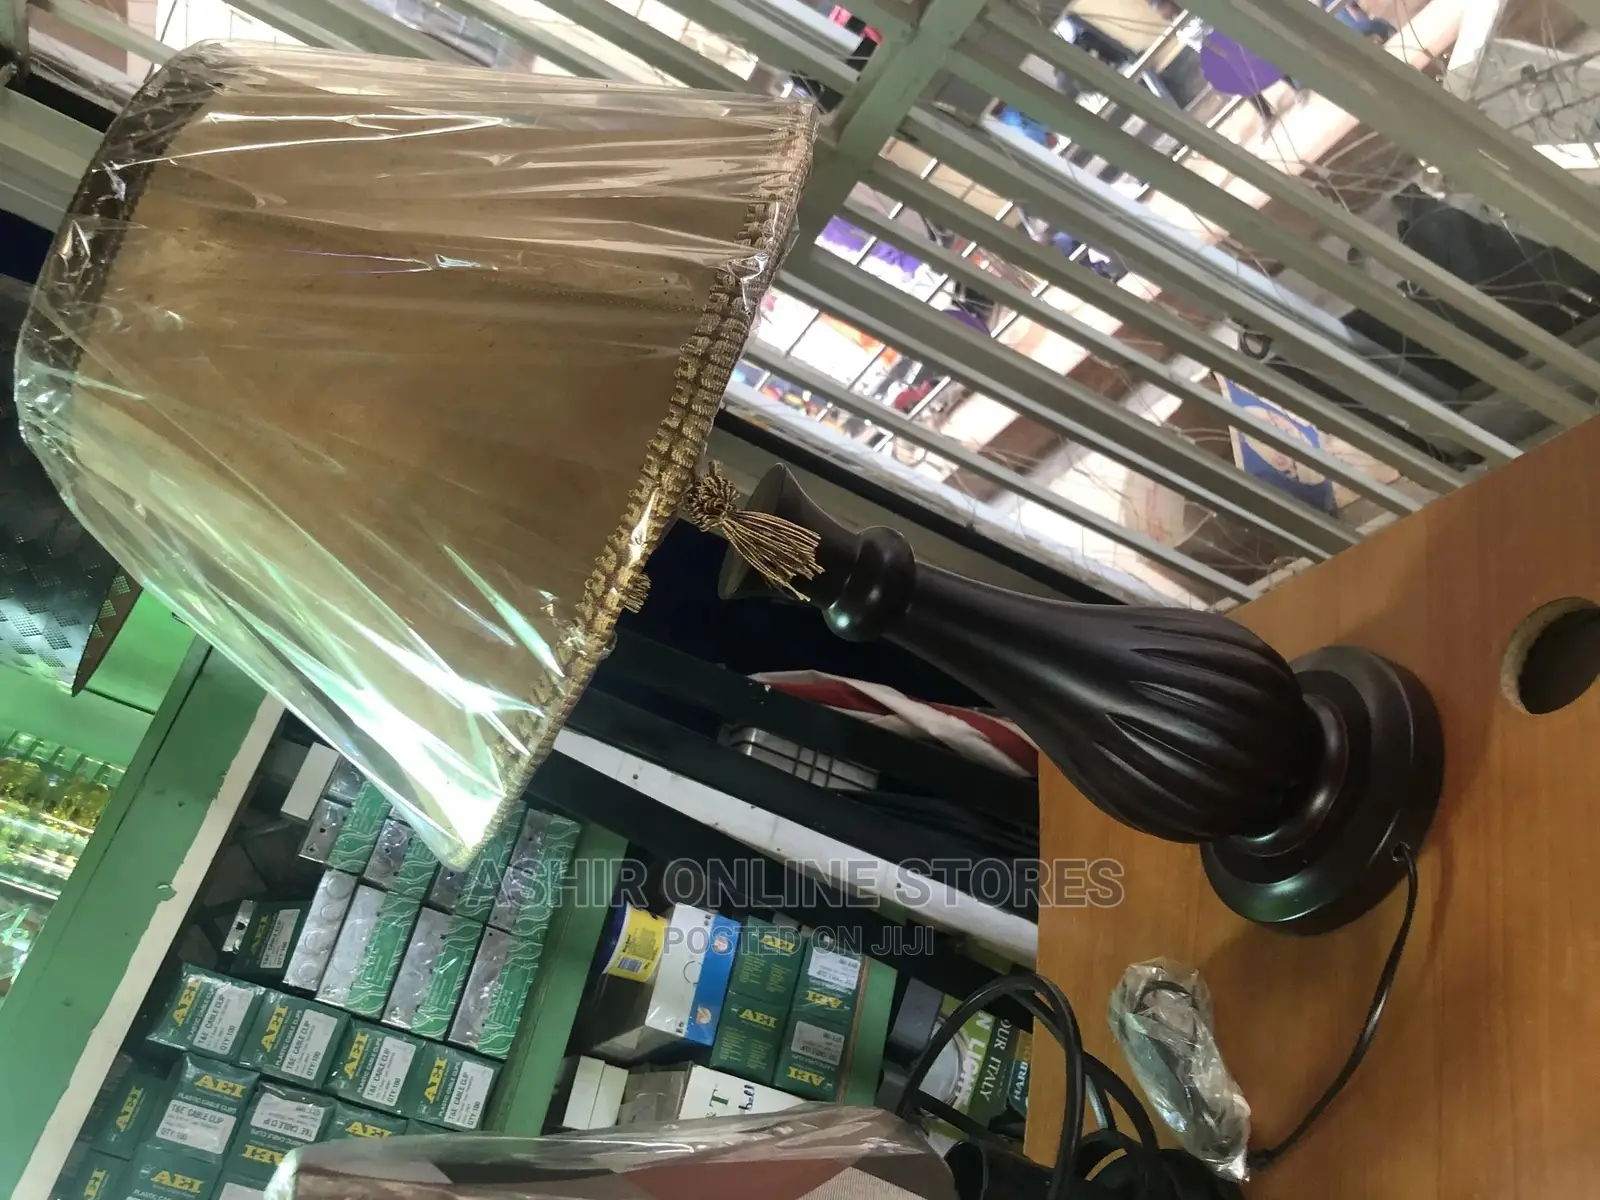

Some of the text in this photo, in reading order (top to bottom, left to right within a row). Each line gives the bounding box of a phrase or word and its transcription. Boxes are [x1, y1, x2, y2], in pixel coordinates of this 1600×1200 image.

[173, 979, 202, 1027] AEI
[739, 1008, 778, 1029] AEI
[261, 1004, 289, 1053] AEI
[344, 1031, 369, 1080] AEI
[786, 1066, 825, 1087] AEI
[194, 1074, 247, 1098] AEI
[424, 1056, 448, 1104] AEI
[980, 1056, 1002, 1102] ITALY
[116, 1085, 144, 1132] AEI
[84, 1167, 107, 1200] EI
[150, 1170, 204, 1194] AEI
